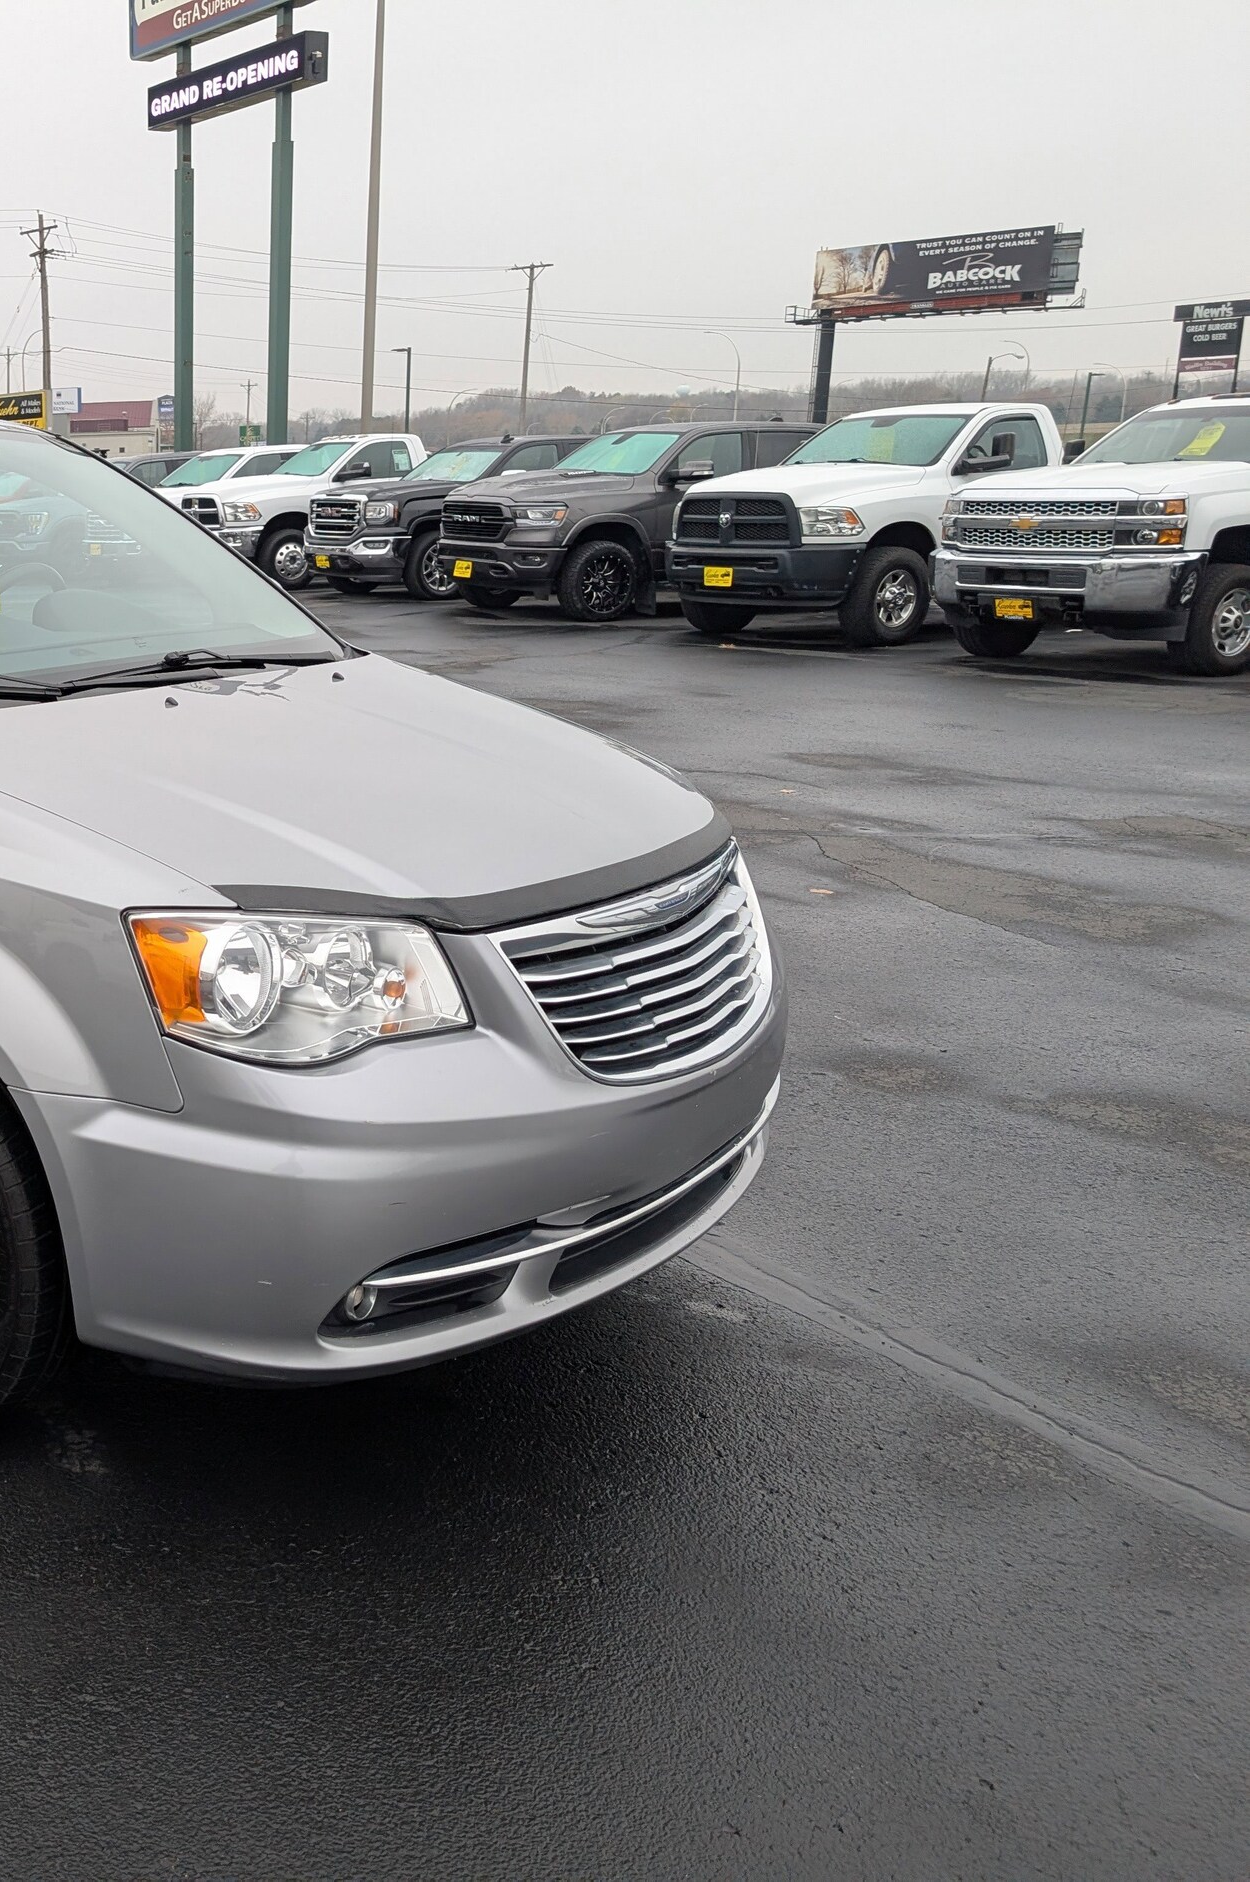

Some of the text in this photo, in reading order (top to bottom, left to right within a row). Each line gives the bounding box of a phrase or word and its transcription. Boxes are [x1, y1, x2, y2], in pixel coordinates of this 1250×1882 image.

[150, 49, 299, 117] GRAND RE-OPENING
[916, 241, 943, 249] TRUST
[985, 233, 1016, 241] COUNT
[919, 248, 946, 257] EVERY
[948, 244, 982, 253] SEASON
[999, 239, 1039, 248] CHANGE.
[927, 264, 1022, 290] BABCOCK
[940, 281, 969, 289] AUTO
[1193, 302, 1233, 318] Newt's
[1185, 322, 1237, 333] GREAT BURGERS
[452, 514, 480, 523] RAM
